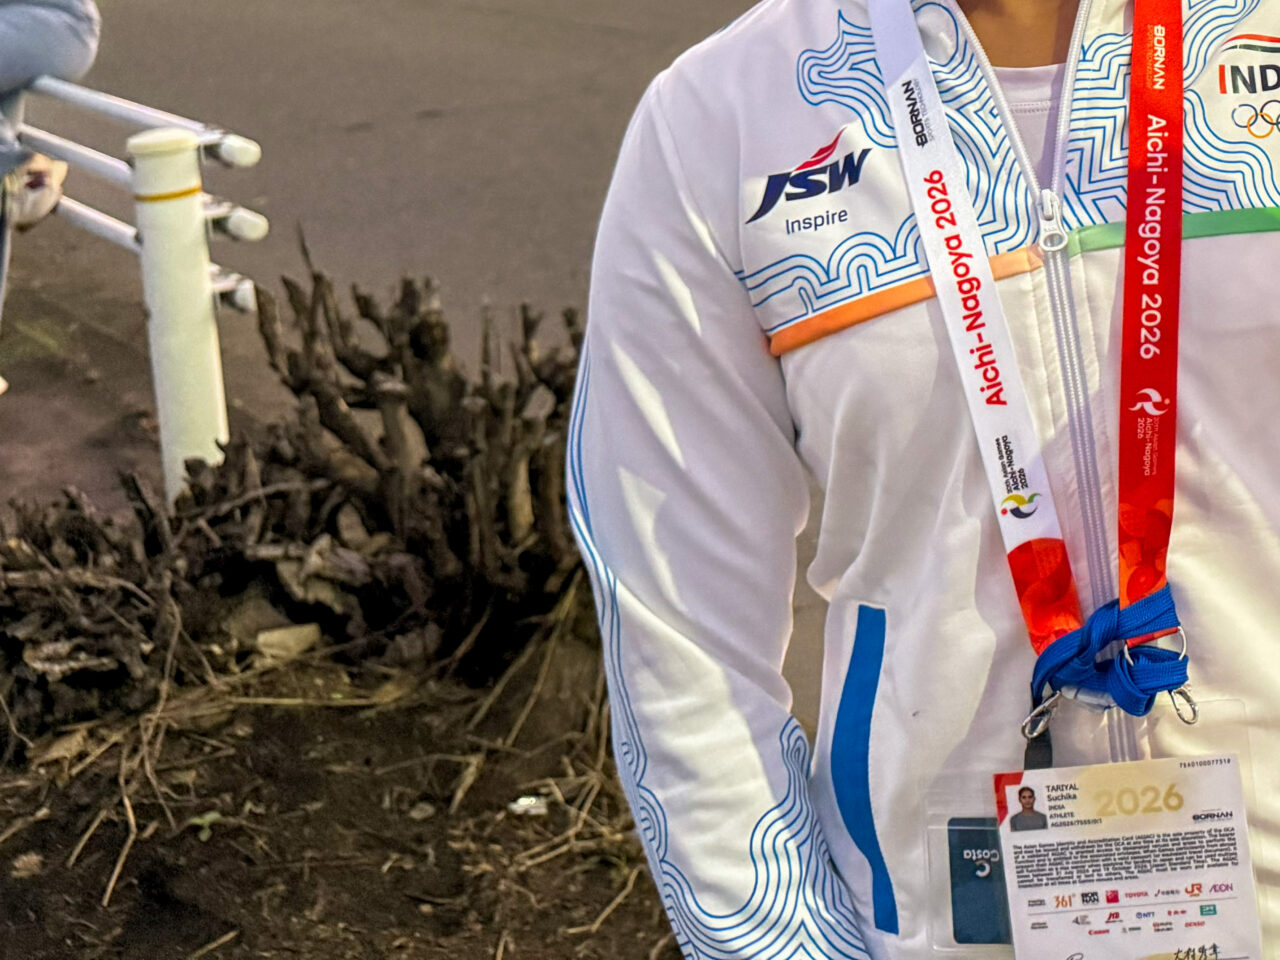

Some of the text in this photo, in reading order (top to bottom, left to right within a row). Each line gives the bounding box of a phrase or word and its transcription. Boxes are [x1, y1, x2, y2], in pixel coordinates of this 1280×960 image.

[1153, 24, 1165, 90] BORNAN
[902, 79, 928, 148] BORNAN
[746, 148, 872, 225] JSW
[786, 209, 849, 235] Inspire
[1137, 114, 1169, 360] Aichi-Nagoya 2026
[923, 169, 1008, 407] Aichi-Nagoya 2026
[1137, 418, 1145, 439] 2026
[1017, 468, 1029, 489] 2026
[1046, 784, 1079, 793] TARIYAL
[1047, 794, 1078, 802] Suchika
[1094, 783, 1184, 817] 2026
[1192, 811, 1233, 821] BORNAN
[963, 849, 1000, 862] Costa
[1124, 891, 1149, 899] TOYOTA
